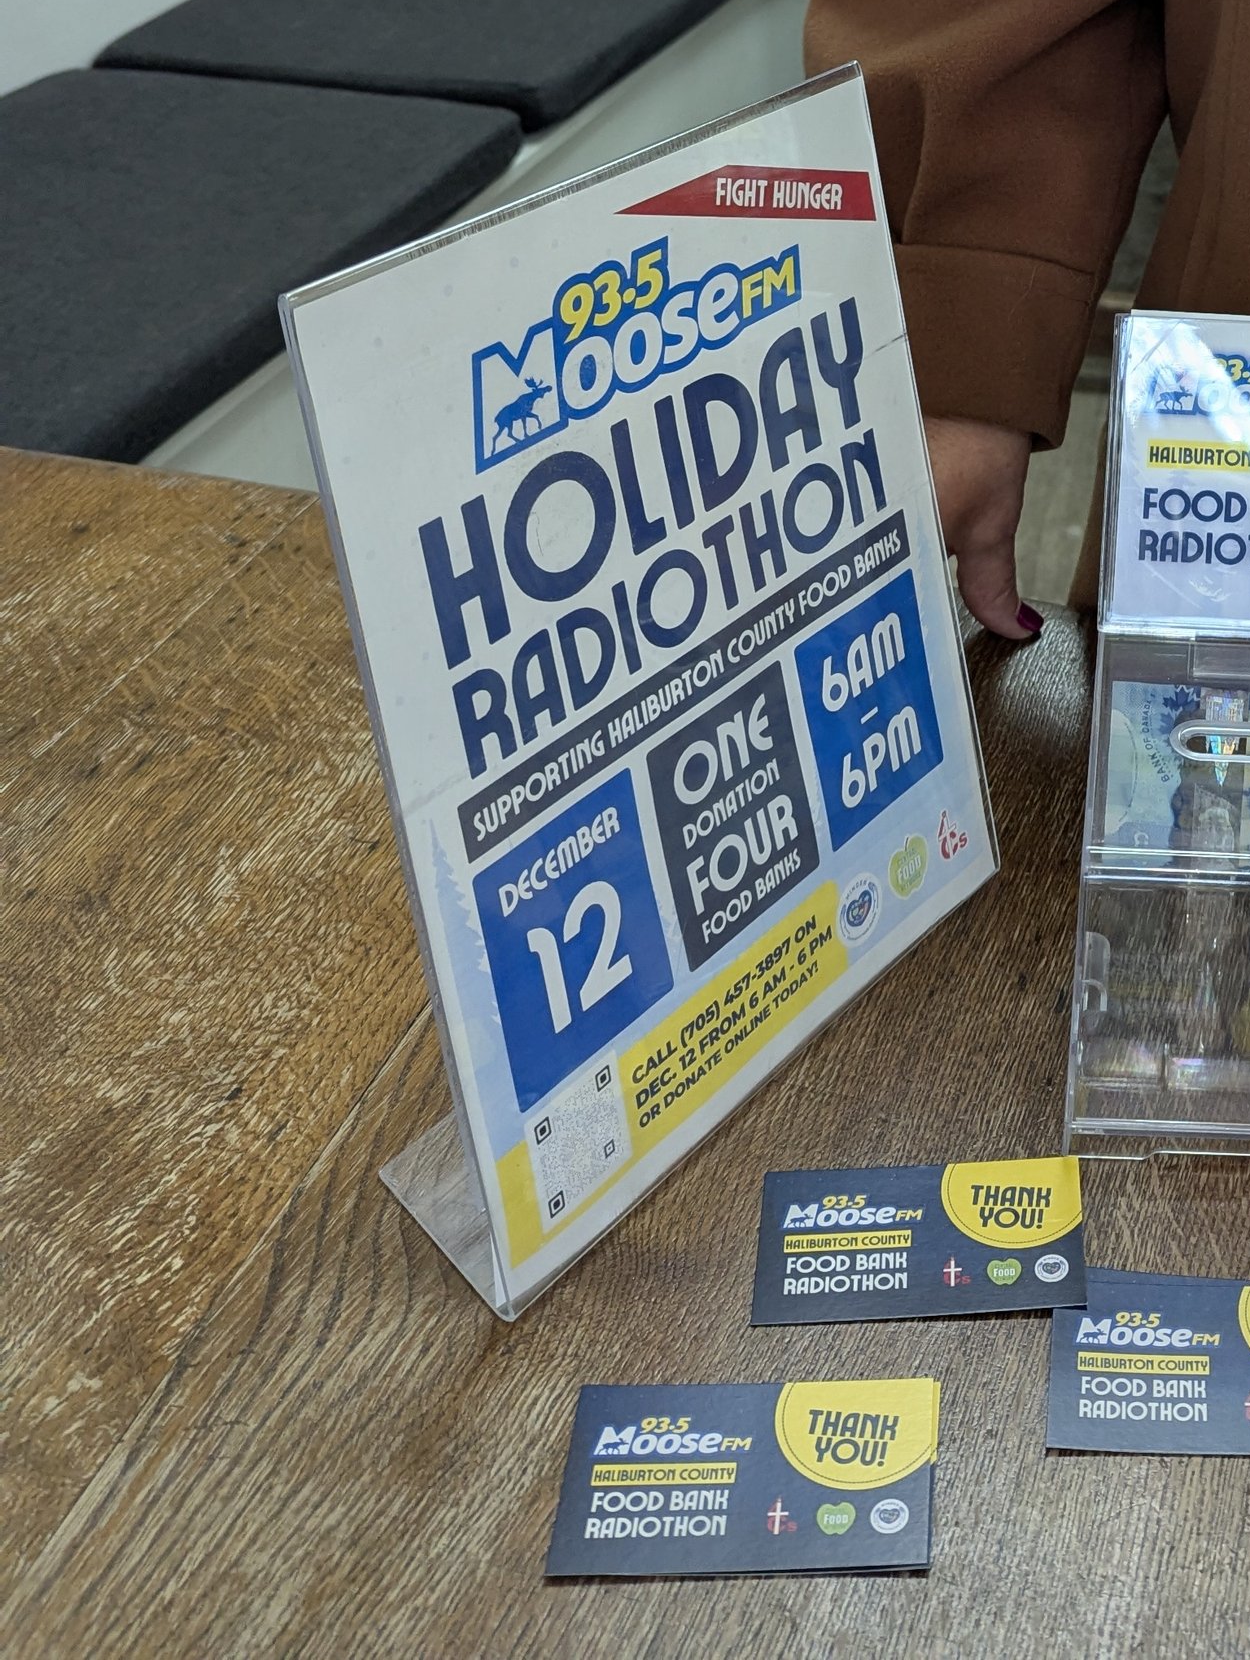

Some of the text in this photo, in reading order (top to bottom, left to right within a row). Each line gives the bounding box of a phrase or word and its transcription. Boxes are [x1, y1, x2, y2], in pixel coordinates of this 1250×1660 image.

[716, 177, 843, 210] FIGHT HUNGER
[560, 250, 665, 339] 93.5
[1149, 445, 1250, 467] HALIBURTON
[418, 296, 864, 671] HOLIDAY
[1142, 487, 1248, 523] FOOD
[452, 427, 888, 780] RADIOTHON
[821, 612, 906, 712] 6AM
[473, 529, 902, 843] SUPPORTING HALIBURTON COUNTY FOOD BANKS
[673, 692, 774, 805] ONE
[840, 706, 921, 808] 6PM
[1150, 751, 1171, 783] BANK
[682, 758, 780, 850] DONATION
[498, 806, 620, 917] DECEMBER
[686, 794, 798, 916] FOUR
[897, 855, 922, 884] FOOD
[702, 848, 801, 944] FOOD BANKS
[526, 880, 633, 1034] 12
[632, 1040, 678, 1084] CALL
[679, 1000, 721, 1048] (705)
[723, 937, 791, 1007] 457-3897
[794, 915, 817, 943] ON
[635, 1067, 677, 1110] DEC.
[678, 1047, 697, 1071] 12
[699, 1004, 746, 1055] FROM
[748, 993, 760, 1010] 6
[762, 967, 787, 1001] AM
[797, 948, 807, 967] 6
[809, 925, 833, 955] PM
[638, 960, 819, 1128] OR DONATE ONLINE TODAY!
[822, 1194, 867, 1210] 93.5
[971, 1184, 1052, 1208] THANK
[979, 1206, 1044, 1229] YOU!
[785, 1233, 910, 1250] HALIBURTON COUNTY
[786, 1251, 907, 1275] FOOD BANK
[993, 1268, 1016, 1277] FOOD
[783, 1271, 908, 1295] RADIOTHON
[1114, 1311, 1161, 1328] 93.5
[1079, 1355, 1208, 1372] HALIBURTON COUNTY
[1081, 1376, 1207, 1399] FOOD BANK
[640, 1416, 691, 1434] 93.5
[808, 1409, 899, 1441] THANK
[1079, 1399, 1208, 1422] RADIOTHON
[815, 1438, 888, 1467] YOU!
[593, 1467, 735, 1483] HALIBURTON COUNTY
[591, 1489, 729, 1513] FOOD BANK
[584, 1515, 727, 1539] RADIOTHON
[824, 1514, 848, 1524] FOOD
